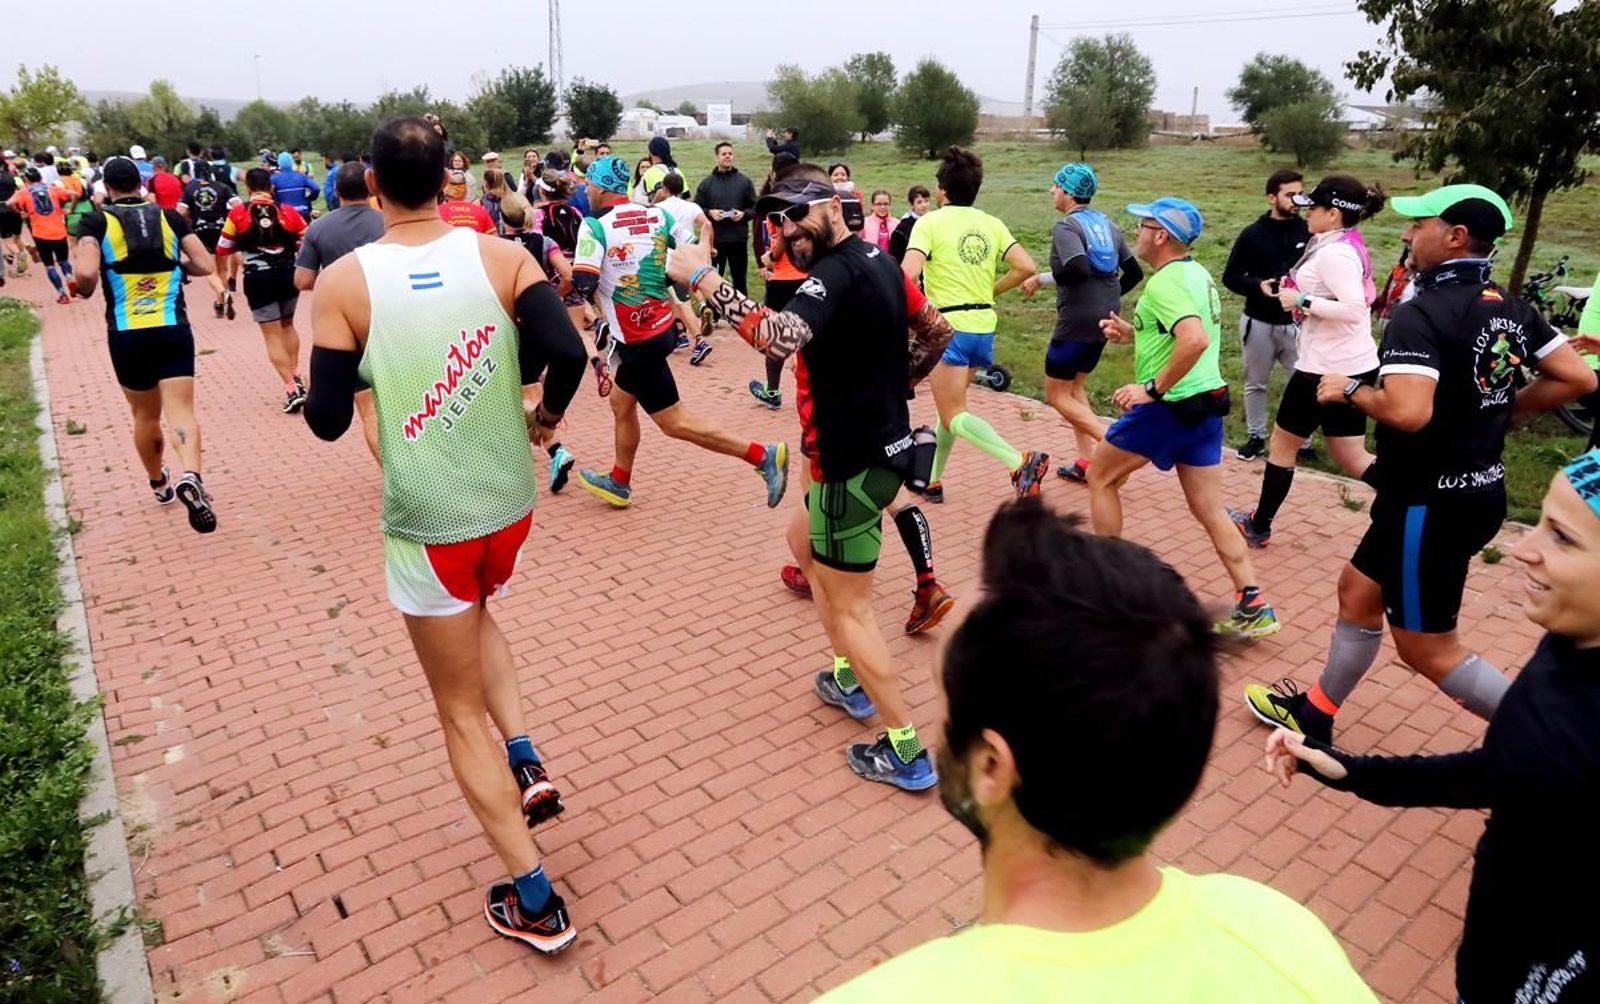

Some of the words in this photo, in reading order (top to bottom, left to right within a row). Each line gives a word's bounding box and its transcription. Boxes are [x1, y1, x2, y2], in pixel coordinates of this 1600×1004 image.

[1472, 327, 1490, 354] LOS
[404, 324, 496, 440] maratón
[441, 357, 497, 430] JEREZ
[1437, 474, 1467, 490] LOS
